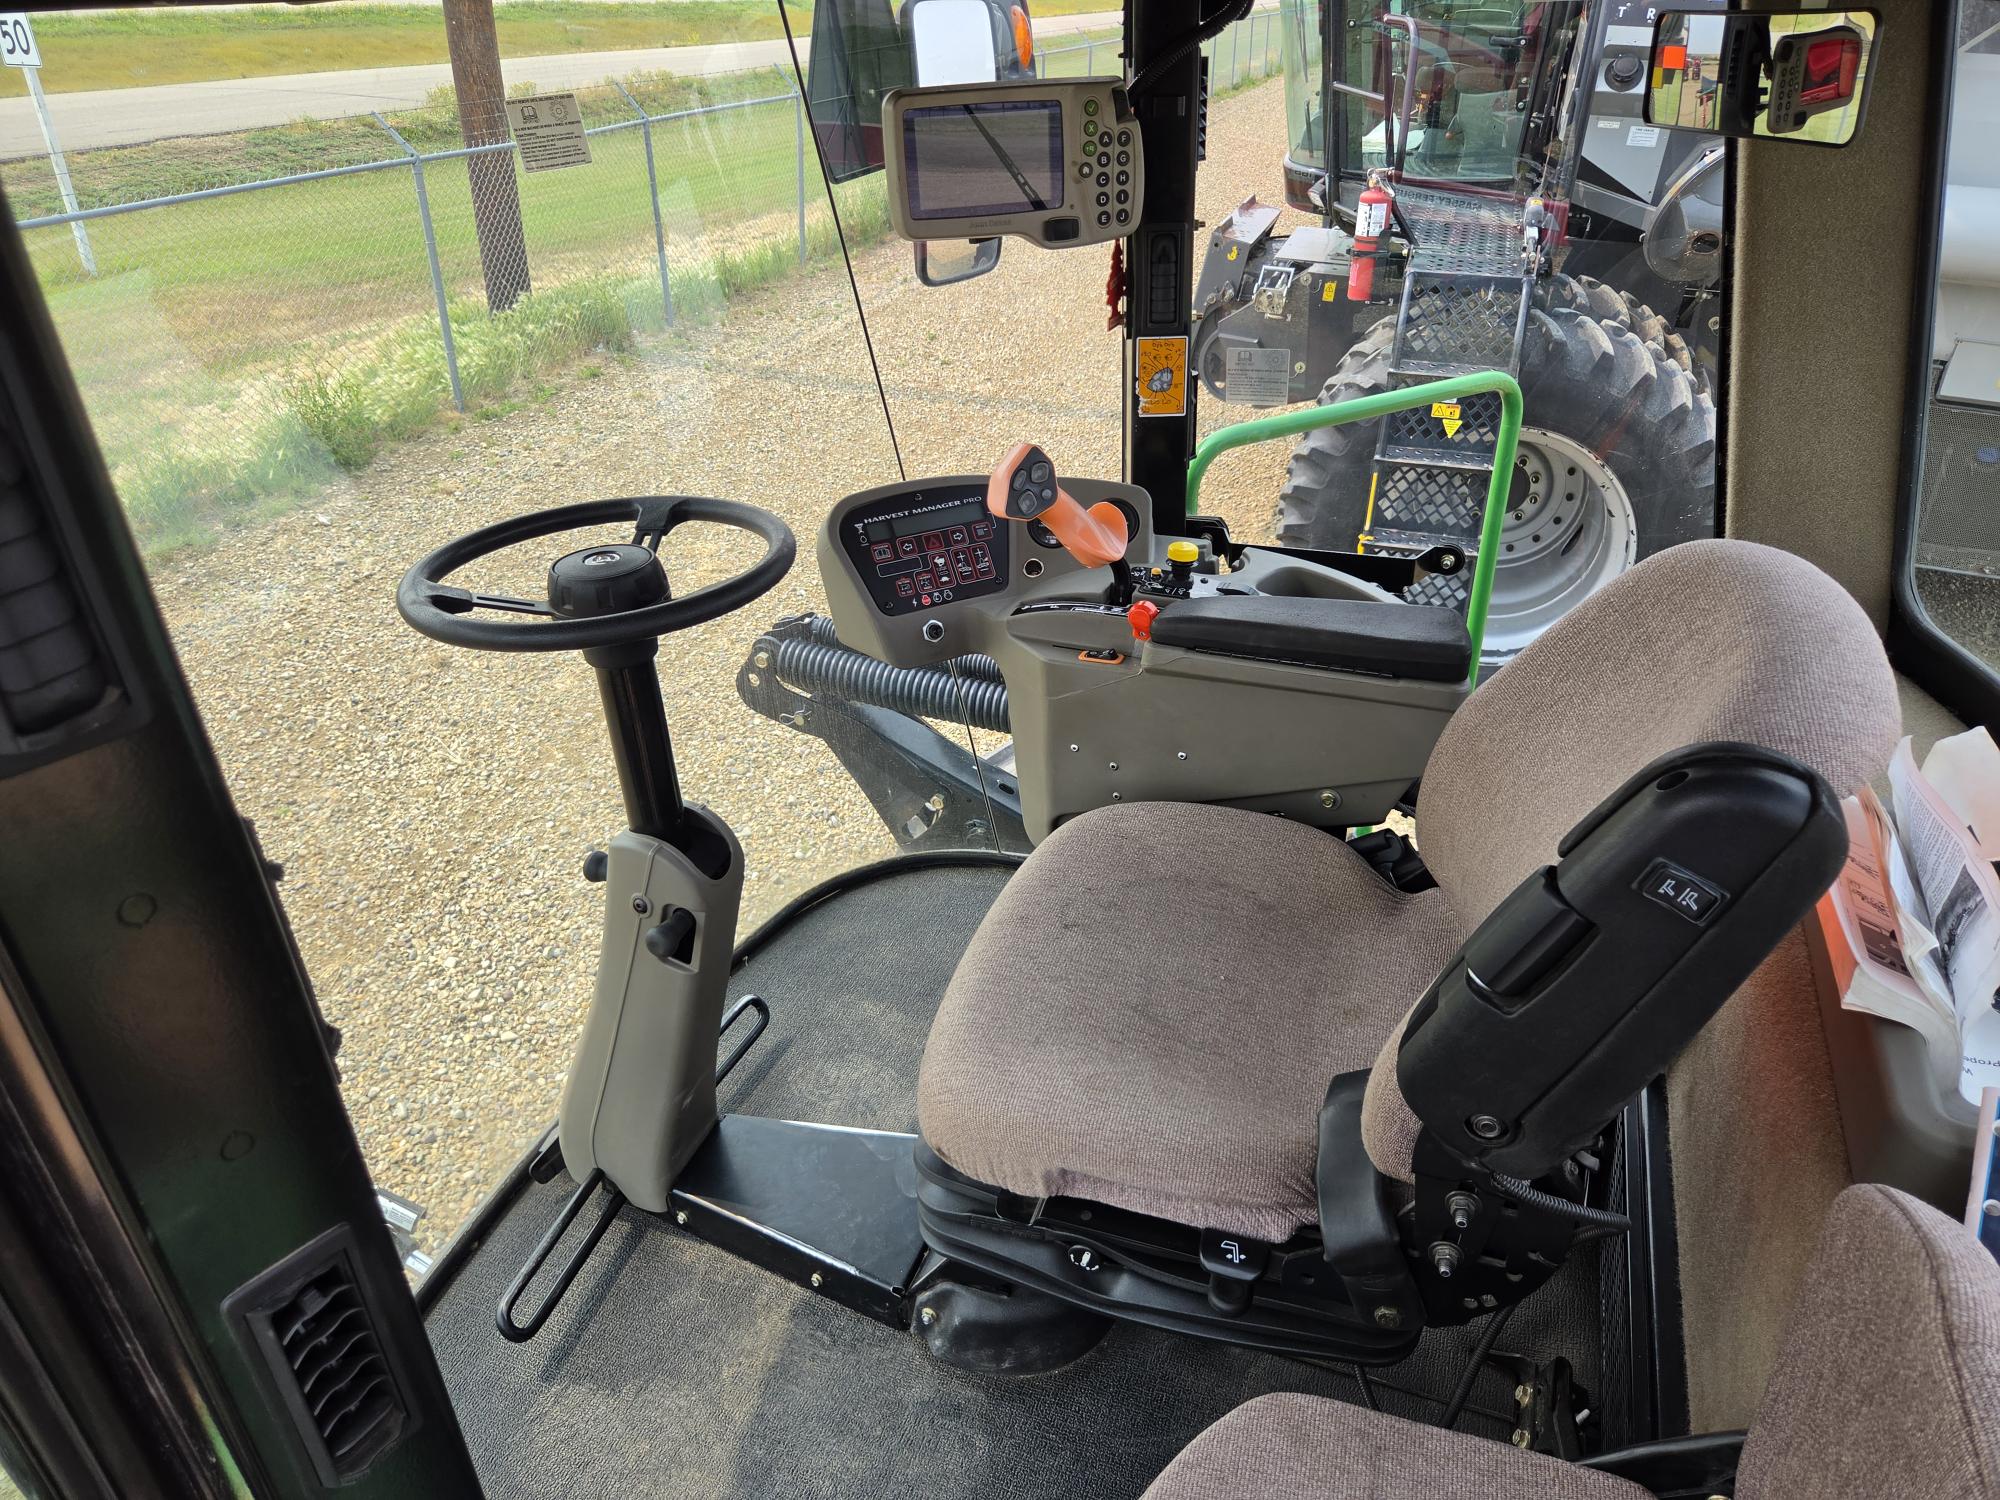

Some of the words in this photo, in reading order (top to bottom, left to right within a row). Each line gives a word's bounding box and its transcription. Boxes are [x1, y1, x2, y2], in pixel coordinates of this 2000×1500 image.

[0, 19, 30, 55] 50
[1103, 135, 1109, 143] A
[1101, 156, 1107, 164] B
[1120, 174, 1126, 182] H
[1100, 195, 1106, 203] D
[1101, 215, 1107, 223] E
[1120, 212, 1125, 220] J
[863, 510, 909, 524] HARVEST
[912, 500, 961, 514] MANAGER
[963, 496, 982, 504] PRO
